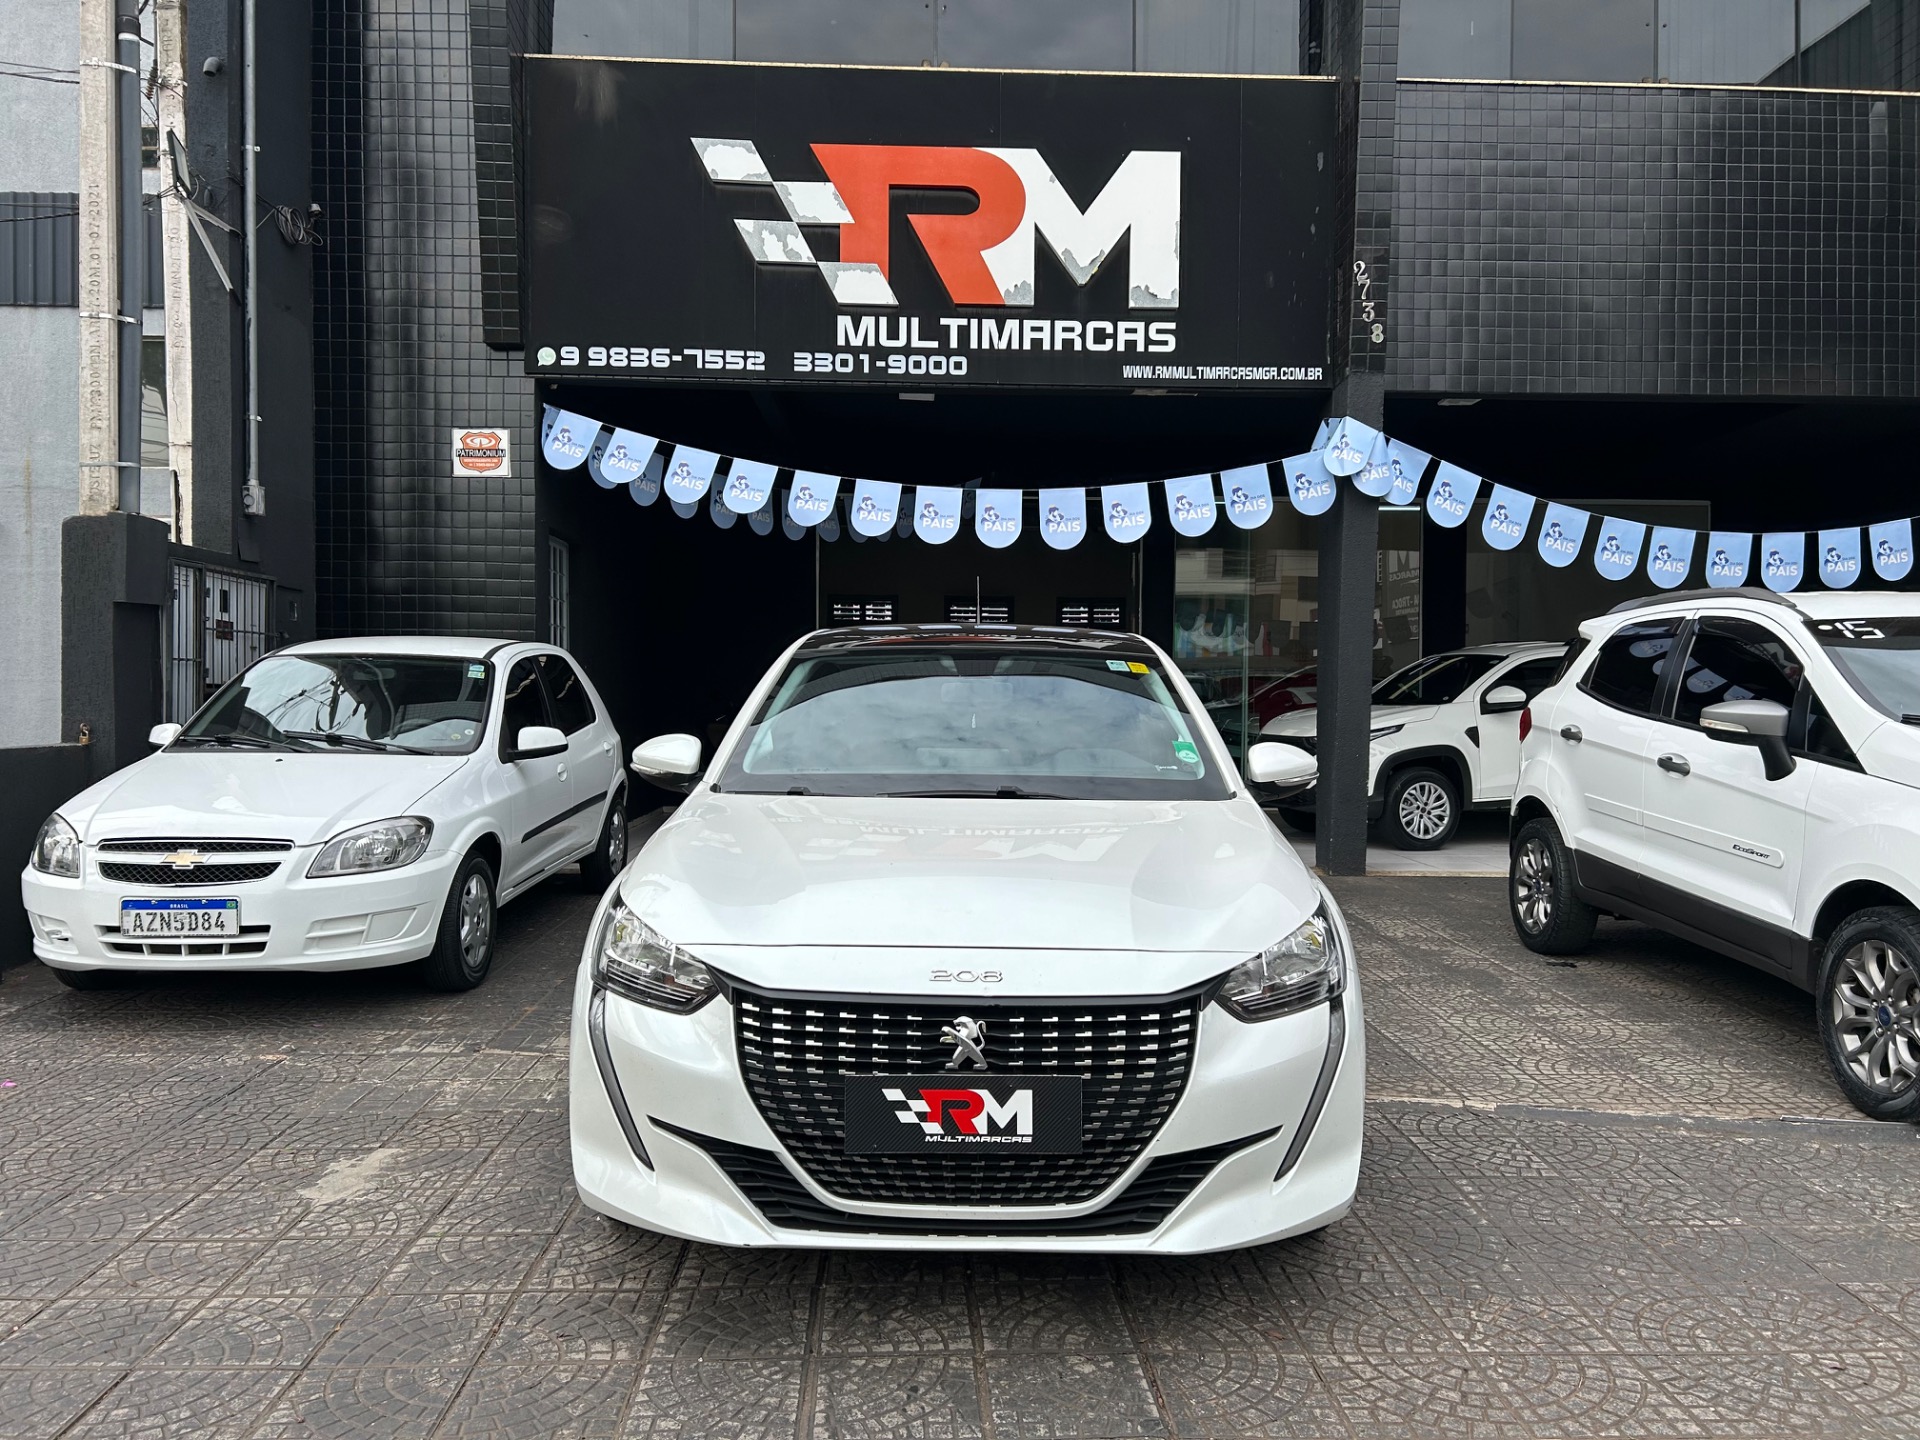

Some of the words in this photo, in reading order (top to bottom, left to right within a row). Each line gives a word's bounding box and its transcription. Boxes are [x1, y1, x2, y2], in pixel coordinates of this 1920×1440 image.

[809, 143, 1182, 309] RM
[1353, 260, 1384, 343] 2738
[836, 315, 1177, 353] MULTIMARCAS
[560, 346, 580, 366] 9
[587, 347, 766, 371] 9836-7552
[793, 352, 968, 376] 3301-9000
[1122, 365, 1323, 380] WWW.RMMULTIMARCASMGA.COM.BR
[457, 449, 506, 457] PATRIMONIUM
[552, 442, 584, 458] PAIS
[1331, 449, 1363, 464] PAIS
[608, 458, 641, 472] PAIS
[1361, 465, 1390, 482] PAIS
[672, 475, 705, 490] PAIS
[1393, 479, 1414, 494] AIS
[730, 488, 764, 502] PAIS
[1298, 483, 1331, 500] PAIS
[796, 499, 828, 512] PAIS
[1234, 498, 1267, 514] PAIS
[1434, 497, 1465, 516] PAIS
[859, 510, 892, 522] PAIS
[1113, 514, 1146, 529] PAIS
[1178, 507, 1211, 521] PAIS
[922, 517, 954, 529] PAIS
[984, 521, 1016, 532] PAIS
[1049, 521, 1081, 533] PAIS
[1490, 519, 1522, 537] PAIS
[1545, 536, 1576, 554] PAIS
[1602, 551, 1634, 566] PAIS
[1880, 552, 1909, 566] PAIS
[1654, 560, 1685, 573] PAIS
[1713, 565, 1743, 577] PAIS
[1769, 565, 1798, 576] PAIS
[1827, 560, 1856, 573] PAIS
[133, 911, 226, 933] AZN5D84
[928, 969, 1004, 983] 208
[918, 1089, 1033, 1135] RM
[924, 1135, 1033, 1144] MULTIMARCAS
